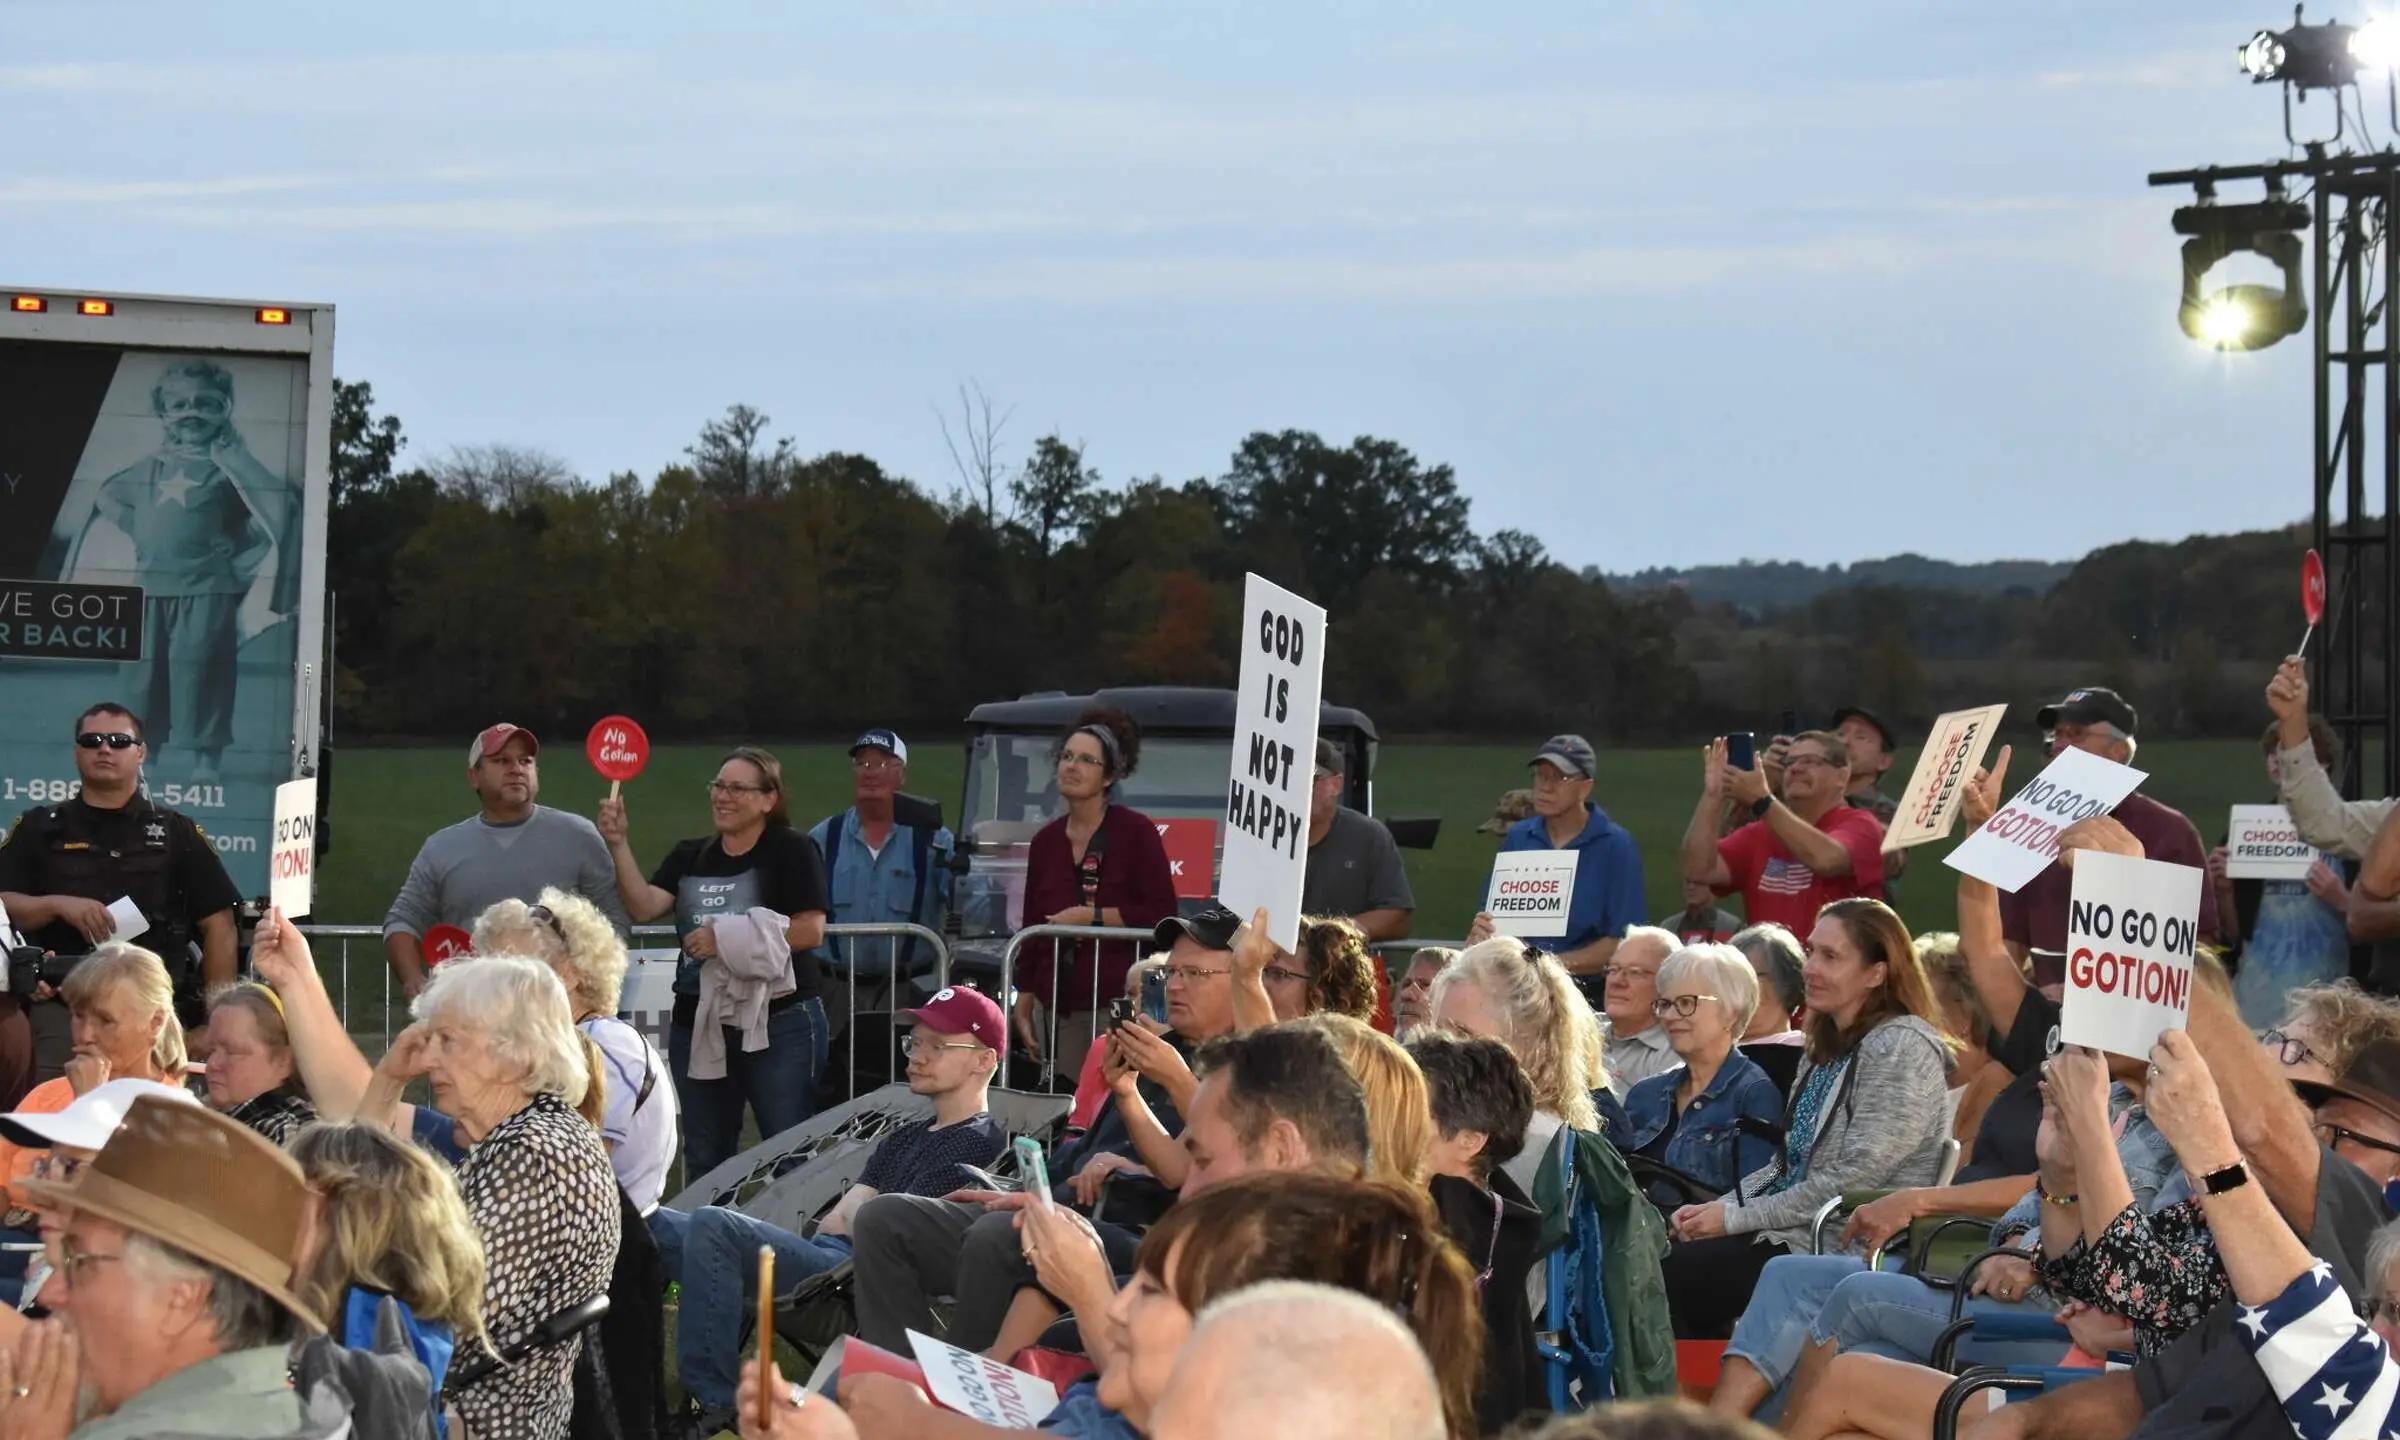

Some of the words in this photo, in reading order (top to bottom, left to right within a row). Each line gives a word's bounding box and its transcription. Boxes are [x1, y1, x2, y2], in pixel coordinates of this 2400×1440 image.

[51, 593, 128, 620] GOT
[23, 623, 128, 649] BACK!
[1260, 609, 1304, 667] GOD
[1264, 673, 1289, 724] IS
[603, 728, 627, 745] No
[1249, 731, 1295, 792] NOT
[1925, 722, 1979, 829] FREEDOM
[1915, 730, 1963, 825] CHOOSE
[2017, 777, 2056, 805] NO
[2046, 789, 2082, 816] GO
[293, 815, 313, 840] ON
[1228, 779, 1302, 860] HAPPY
[2237, 845, 2309, 857] FREEDOM
[2243, 831, 2297, 843] CHOOS
[699, 883, 736, 892] LETS
[702, 896, 725, 907] GO
[1500, 880, 1560, 894] CHOOSE
[1492, 897, 1561, 911] FREEDOM
[2070, 900, 2114, 939] NO
[2121, 908, 2157, 948] GO
[2163, 916, 2196, 957] ON
[2070, 947, 2189, 1011] GOTION!
[945, 1344, 978, 1375] ON
[957, 1374, 990, 1402] GO
[981, 1360, 1034, 1431] OTION!
